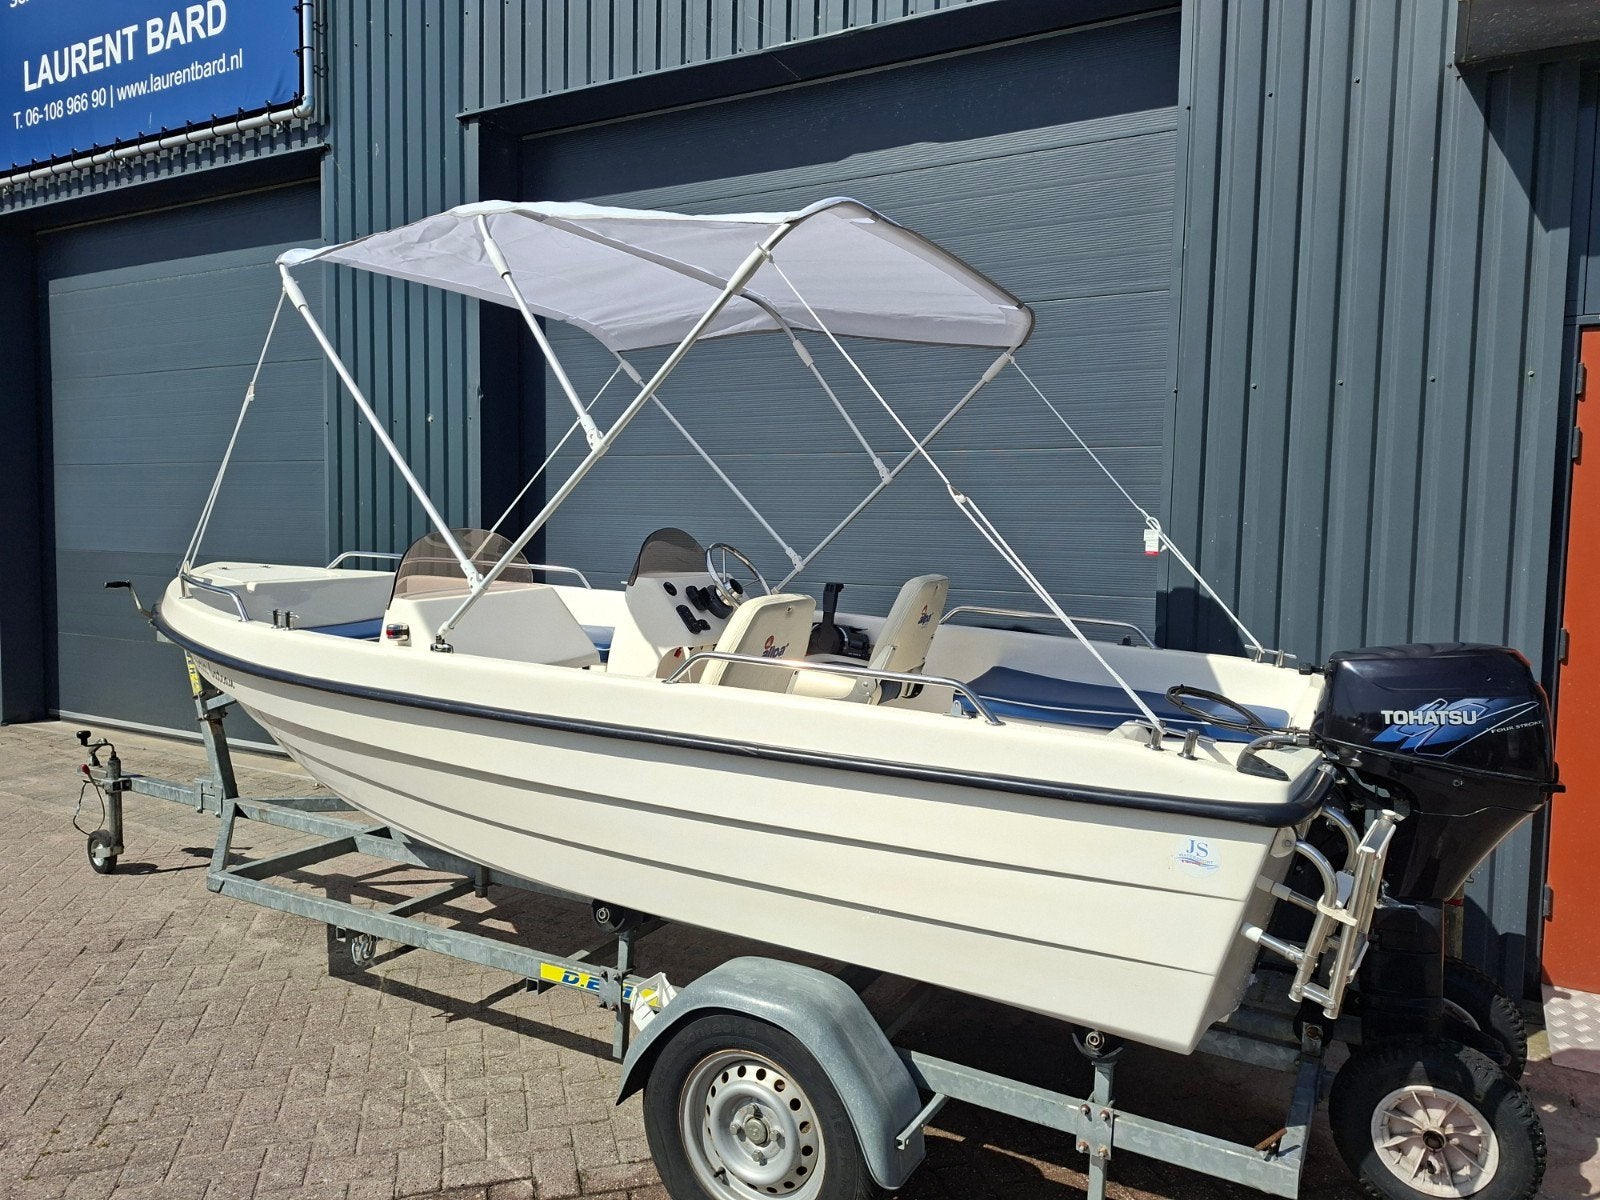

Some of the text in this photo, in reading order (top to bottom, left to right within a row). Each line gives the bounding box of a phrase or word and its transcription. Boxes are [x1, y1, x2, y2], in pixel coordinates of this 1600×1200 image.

[24, 0, 227, 92] LAURENT BARD
[13, 112, 23, 129] T.
[25, 99, 64, 126] 06-108
[66, 93, 88, 115] 966
[91, 87, 107, 108] 90
[117, 48, 243, 101] www.laurentbard.nl
[1381, 710, 1477, 725] TOHATSU
[1490, 726, 1515, 734] FOUR
[1186, 839, 1209, 858] JS
